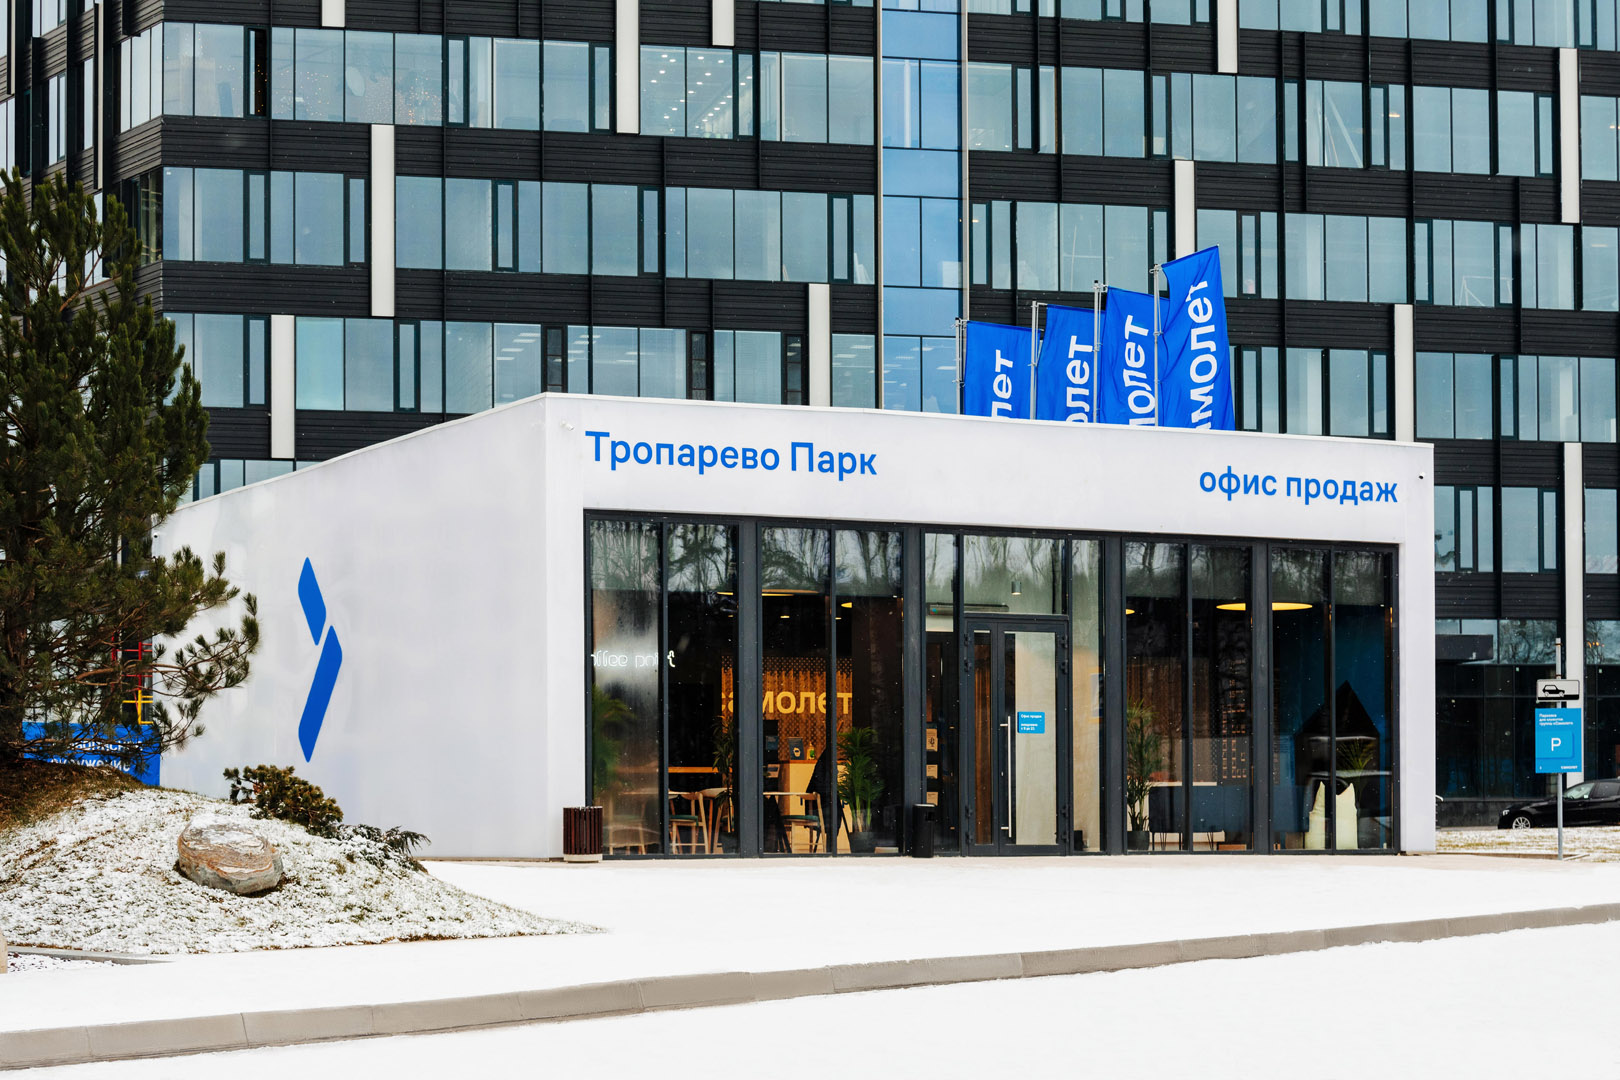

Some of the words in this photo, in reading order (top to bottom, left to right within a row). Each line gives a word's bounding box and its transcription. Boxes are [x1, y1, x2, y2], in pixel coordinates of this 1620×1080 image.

[585, 430, 780, 475] Тропарево
[790, 441, 877, 481] Парк
[1199, 465, 1277, 501] офис
[1286, 476, 1398, 506] продаж
[635, 649, 676, 669] poit
[1551, 738, 1561, 751] P
